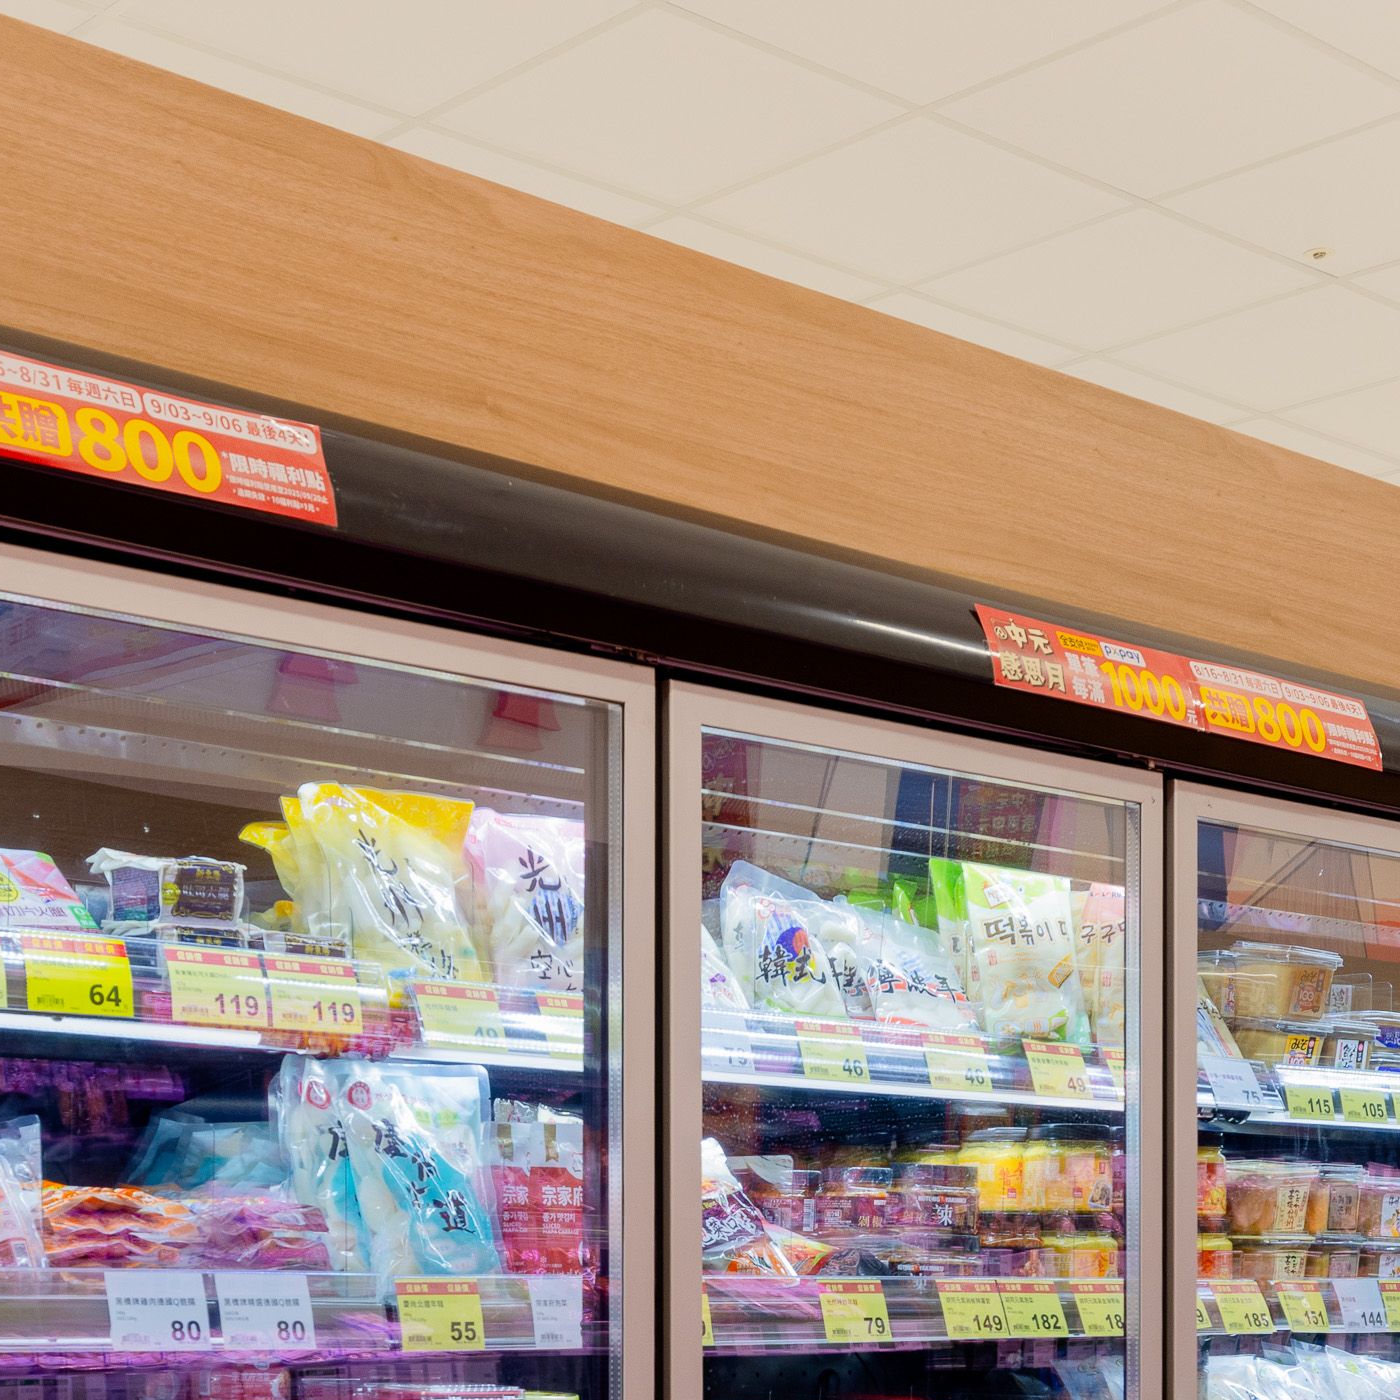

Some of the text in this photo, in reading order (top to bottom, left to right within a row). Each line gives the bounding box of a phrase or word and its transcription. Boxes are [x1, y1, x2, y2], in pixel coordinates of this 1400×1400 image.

[67, 376, 136, 408] 每週六日
[75, 407, 223, 494] 800
[1006, 618, 1053, 655] 中元
[1067, 653, 1100, 676] 單筆
[1103, 645, 1141, 663] pxpay
[1000, 650, 1067, 693] 感恩月
[1072, 676, 1105, 703] 每滿
[1100, 661, 1187, 721] 1000
[1255, 699, 1326, 752] 800
[88, 983, 122, 1008] 64
[214, 993, 259, 1016] 119
[312, 1001, 355, 1024] 119
[841, 1057, 864, 1077] 46
[1067, 1077, 1087, 1093] 49
[1306, 1097, 1332, 1115] 115
[1361, 1100, 1385, 1119] 105
[864, 1317, 886, 1334] 79
[973, 1315, 1003, 1332] 149
[1031, 1313, 1062, 1330] 182
[1243, 1311, 1270, 1329] 185
[1360, 1311, 1384, 1327] 144
[171, 1320, 201, 1342] 80
[276, 1320, 306, 1342] 80
[450, 1321, 477, 1342] 55
